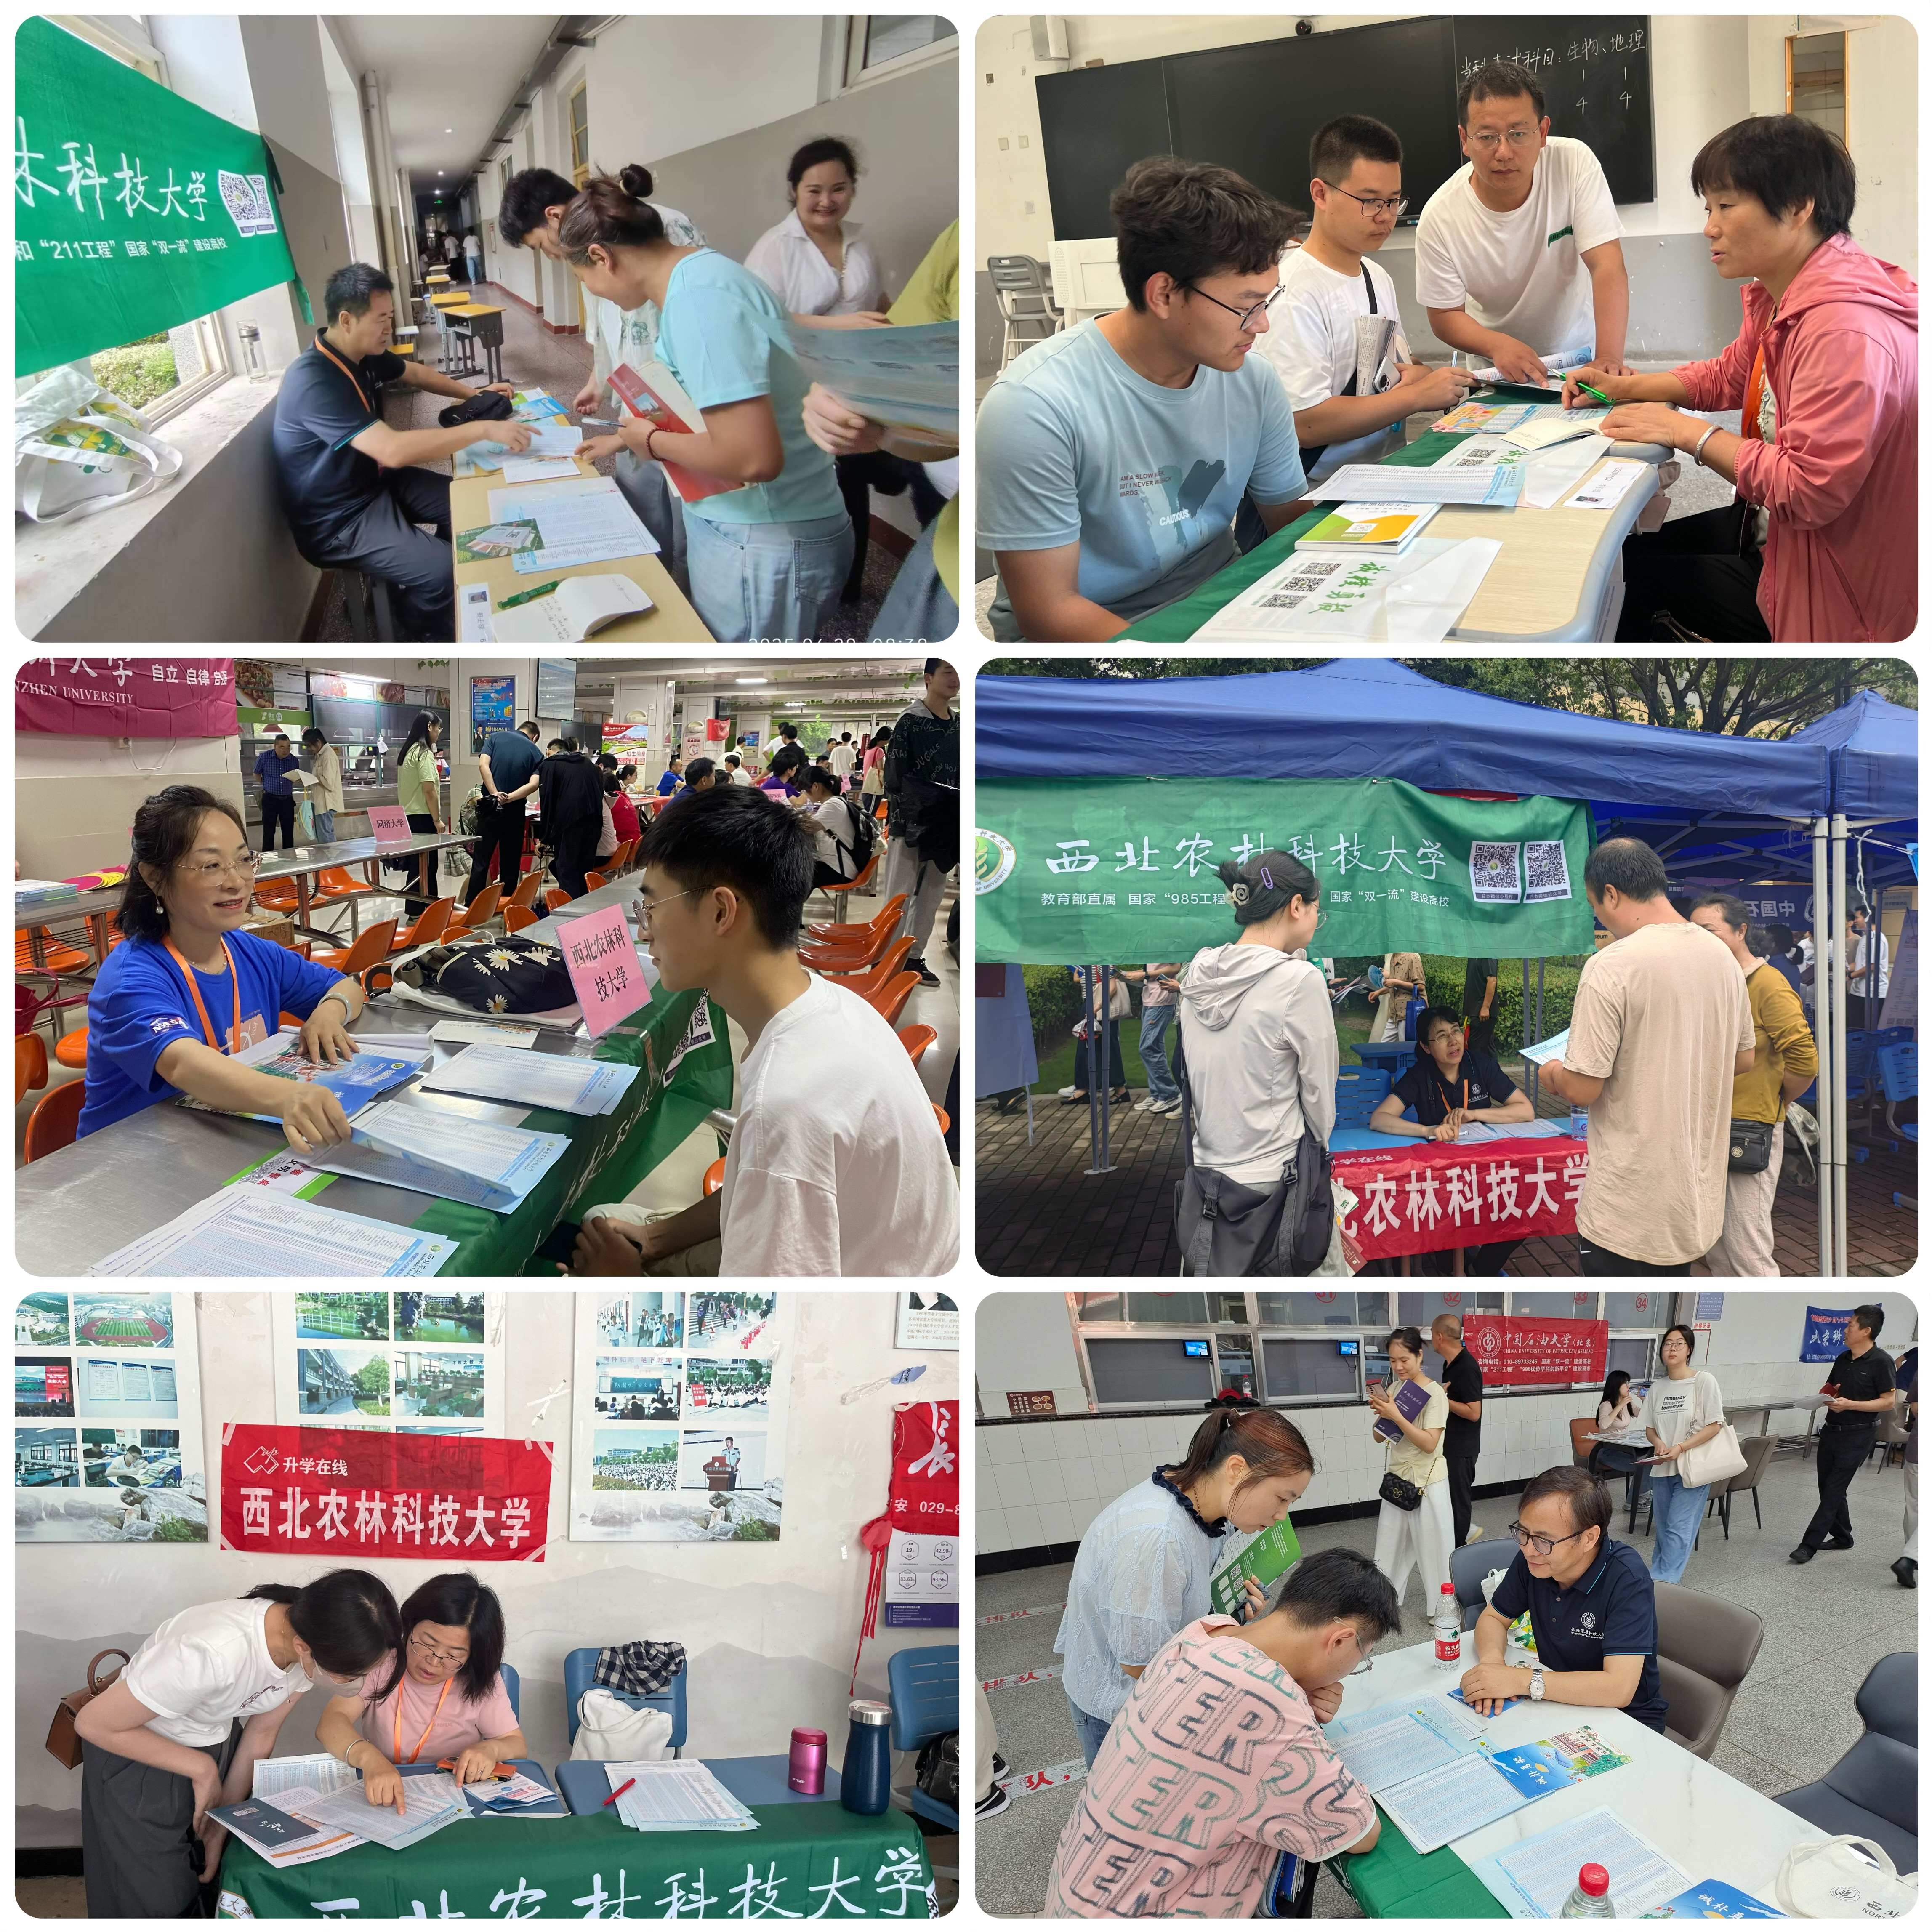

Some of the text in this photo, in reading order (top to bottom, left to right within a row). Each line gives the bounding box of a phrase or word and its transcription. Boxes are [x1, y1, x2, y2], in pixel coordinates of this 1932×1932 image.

[1576, 91, 1632, 115] 4 4
[41, 240, 115, 259] “211工程”
[126, 240, 150, 257] 国家
[192, 237, 228, 253] 建设高校
[1159, 509, 1190, 526] CAUTIOUS
[152, 664, 178, 683] 自立
[186, 668, 210, 686] 自律
[63, 687, 133, 704] UNIVERSITY
[376, 818, 404, 829] 同济大学
[1041, 892, 1116, 905] 教育部直属
[1128, 892, 1157, 905] 国家
[1330, 890, 1352, 902] 国家
[1359, 889, 1405, 902] “双一流”
[1410, 891, 1449, 907] 建设高校
[570, 925, 625, 969] 西北农林科
[594, 966, 628, 1002] 技大学
[1636, 1297, 1647, 1309] 34
[1810, 1328, 1845, 1347] 北京科
[283, 1456, 348, 1477] 升学在线
[240, 1486, 531, 1549] 西北农林科技大学
